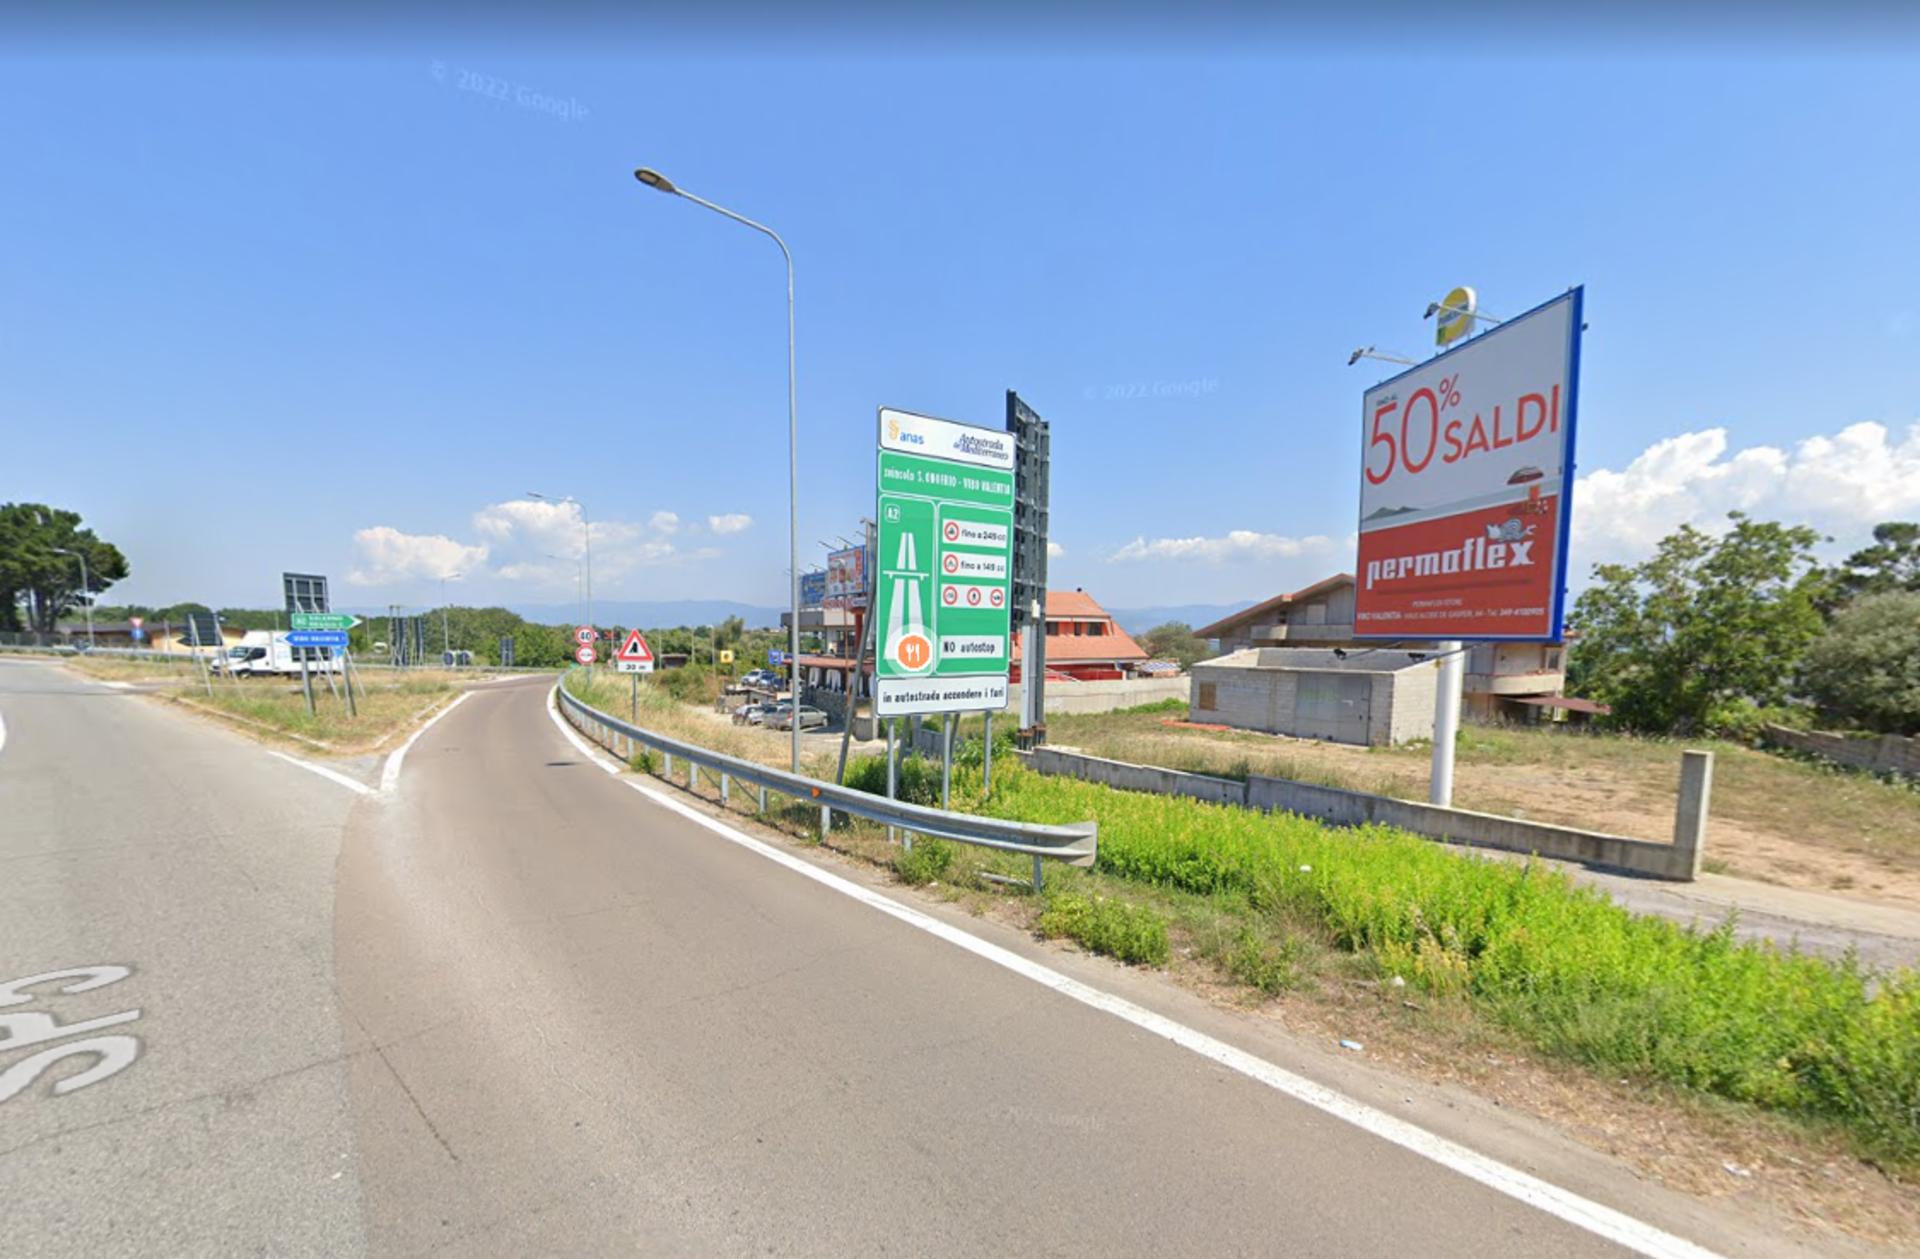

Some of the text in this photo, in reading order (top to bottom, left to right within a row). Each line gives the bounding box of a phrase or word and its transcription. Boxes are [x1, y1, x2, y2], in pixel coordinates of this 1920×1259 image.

[1442, 384, 1560, 463] SALDI
[900, 431, 925, 444] anas
[959, 433, 1004, 451] Autostrada
[886, 507, 899, 520] A2
[961, 529, 976, 539] fino
[961, 561, 975, 570] fino
[1366, 536, 1535, 590] permaflex
[580, 631, 592, 640] 40
[944, 641, 995, 655] NO autostop
[883, 692, 892, 703] in
[894, 690, 940, 703] autostrada
[942, 688, 982, 700] accendere
[990, 686, 1004, 698] fari
